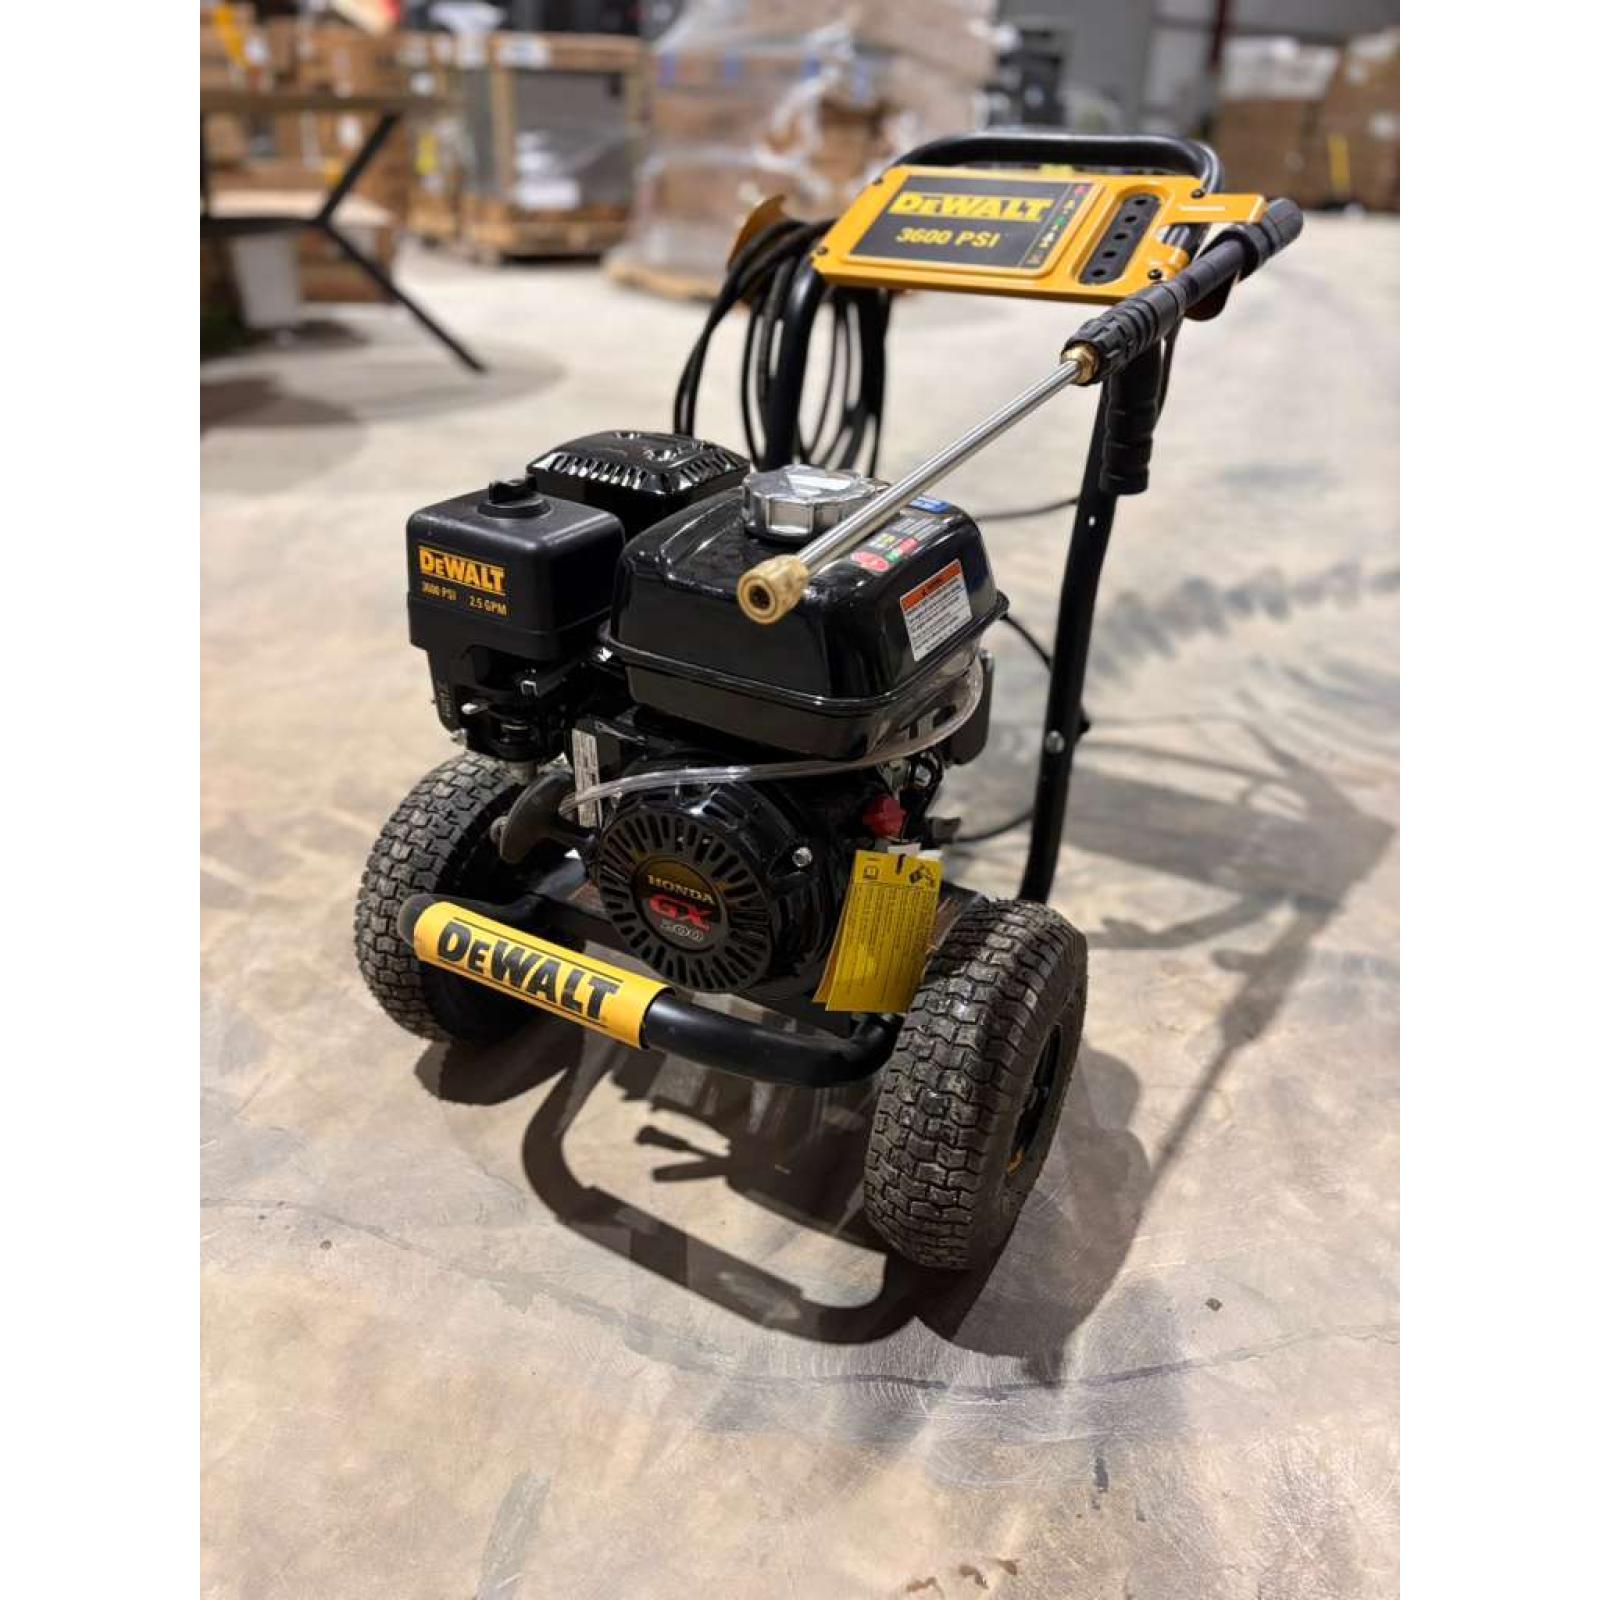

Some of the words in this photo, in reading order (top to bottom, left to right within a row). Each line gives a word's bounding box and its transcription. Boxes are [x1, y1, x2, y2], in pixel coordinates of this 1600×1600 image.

[896, 226, 953, 245] 3600
[955, 230, 1001, 248] PSI
[469, 595, 483, 609] 2.5
[484, 599, 508, 616] GPM
[647, 874, 716, 905] HONDA
[649, 894, 712, 932] GX
